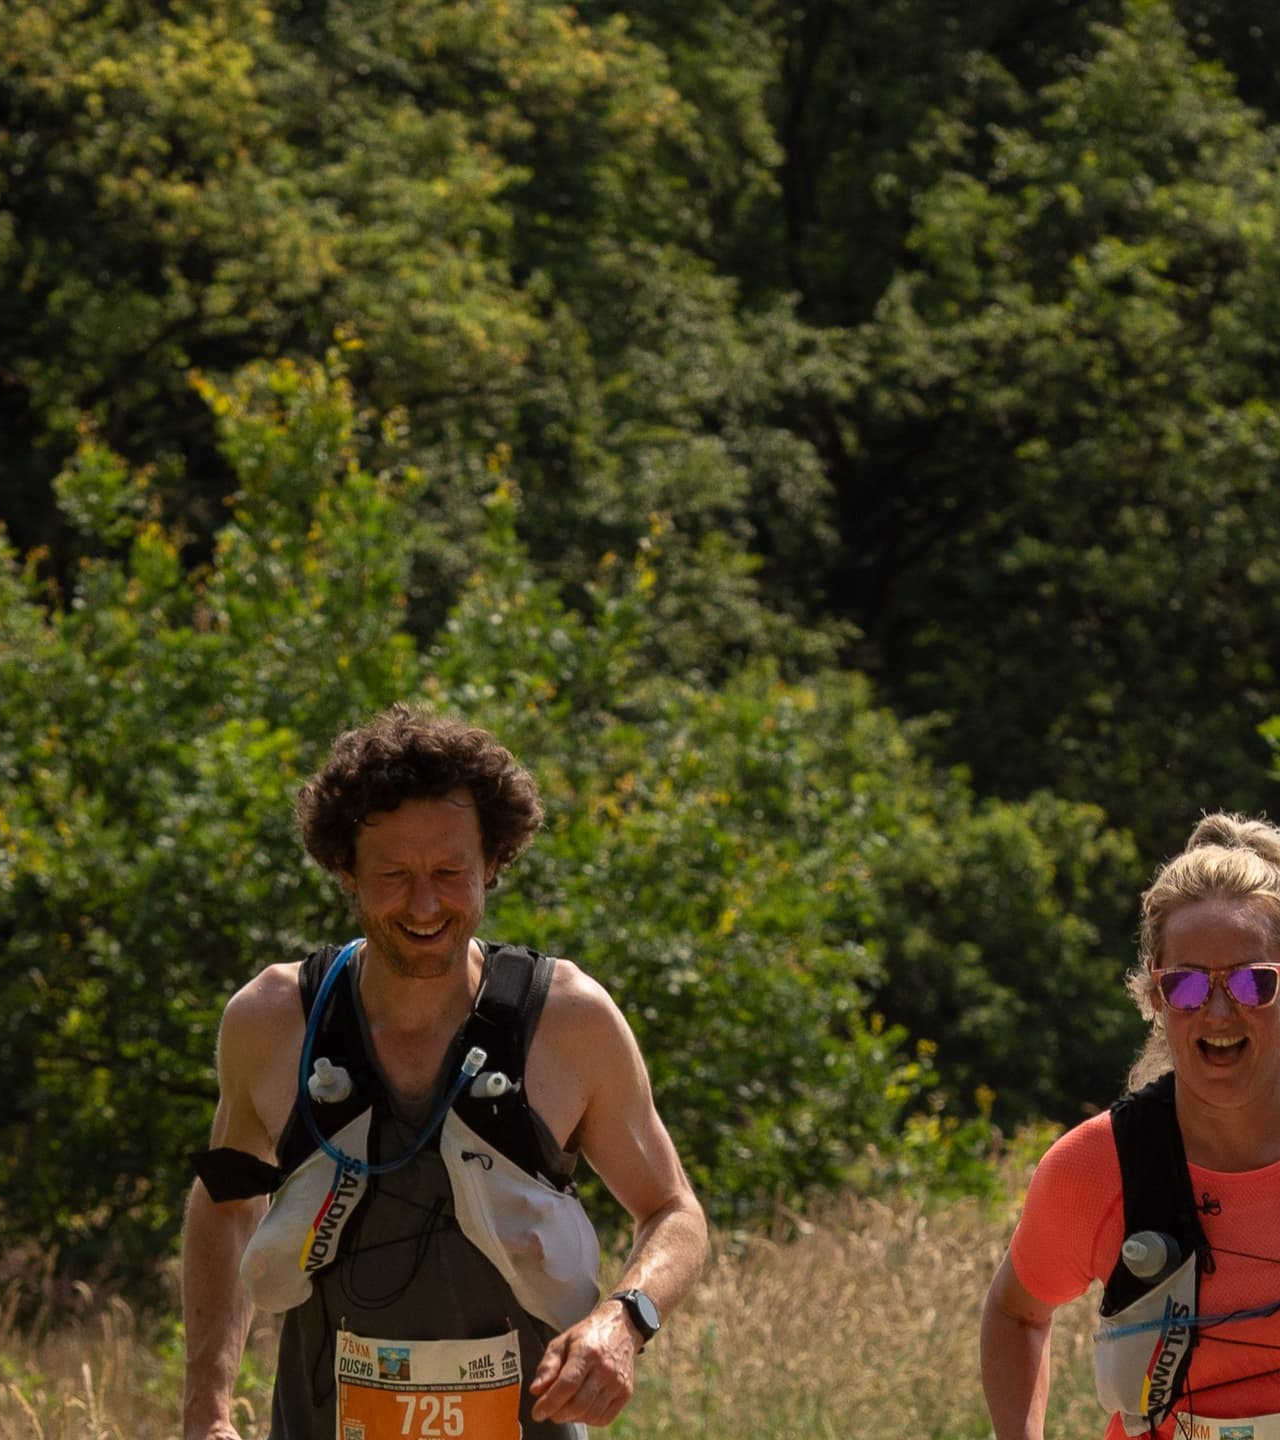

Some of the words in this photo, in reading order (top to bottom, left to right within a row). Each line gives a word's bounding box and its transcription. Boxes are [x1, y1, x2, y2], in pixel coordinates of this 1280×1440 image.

[305, 1157, 361, 1272] SALOMON
[340, 1357, 373, 1376] DUS#6
[468, 1354, 494, 1371] TRAIL
[469, 1368, 495, 1379] EVENTS
[396, 1396, 464, 1436] 725
